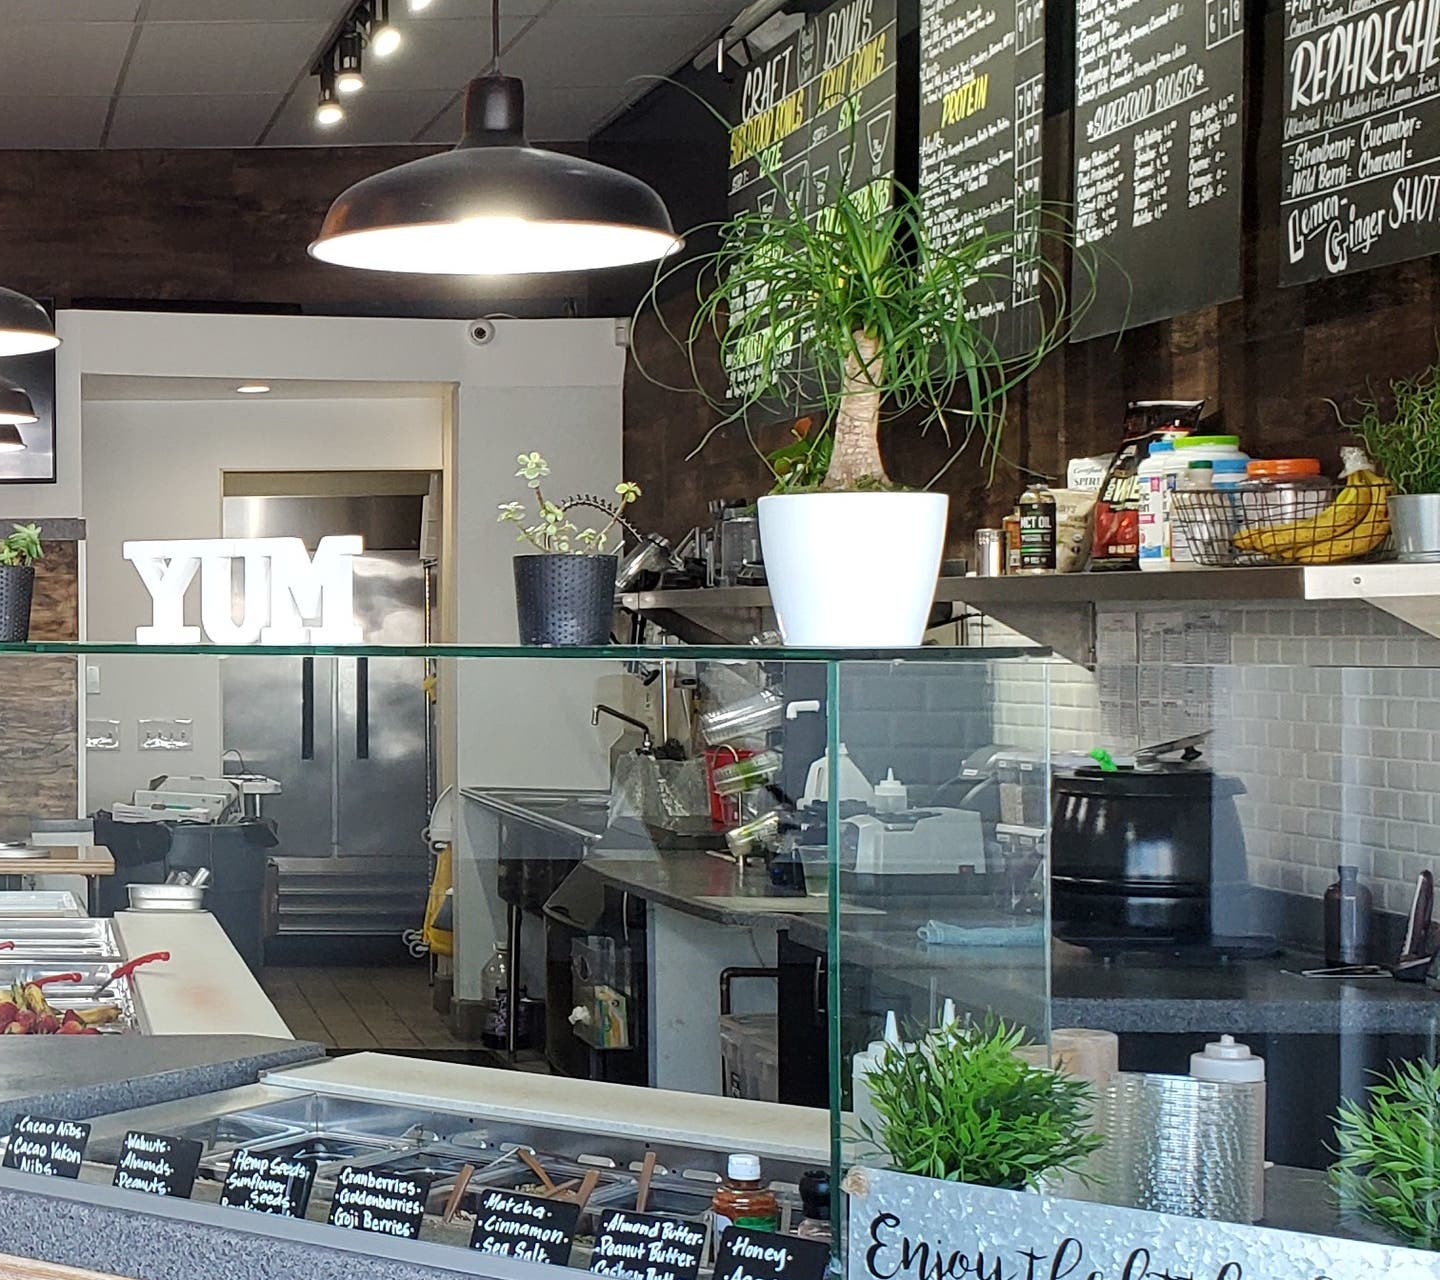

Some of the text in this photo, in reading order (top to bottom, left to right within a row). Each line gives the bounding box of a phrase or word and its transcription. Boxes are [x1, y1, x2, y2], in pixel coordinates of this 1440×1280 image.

[742, 45, 793, 123] CRAFT
[850, 32, 886, 93] BOWLS
[941, 73, 988, 129] PROTEIN
[1389, 175, 1440, 229] SHOT
[122, 535, 363, 645] YUM
[234, 1149, 269, 1175] Hemp
[334, 1207, 359, 1229] Goji
[606, 1213, 660, 1238] Almond
[600, 1235, 646, 1260] Peanut
